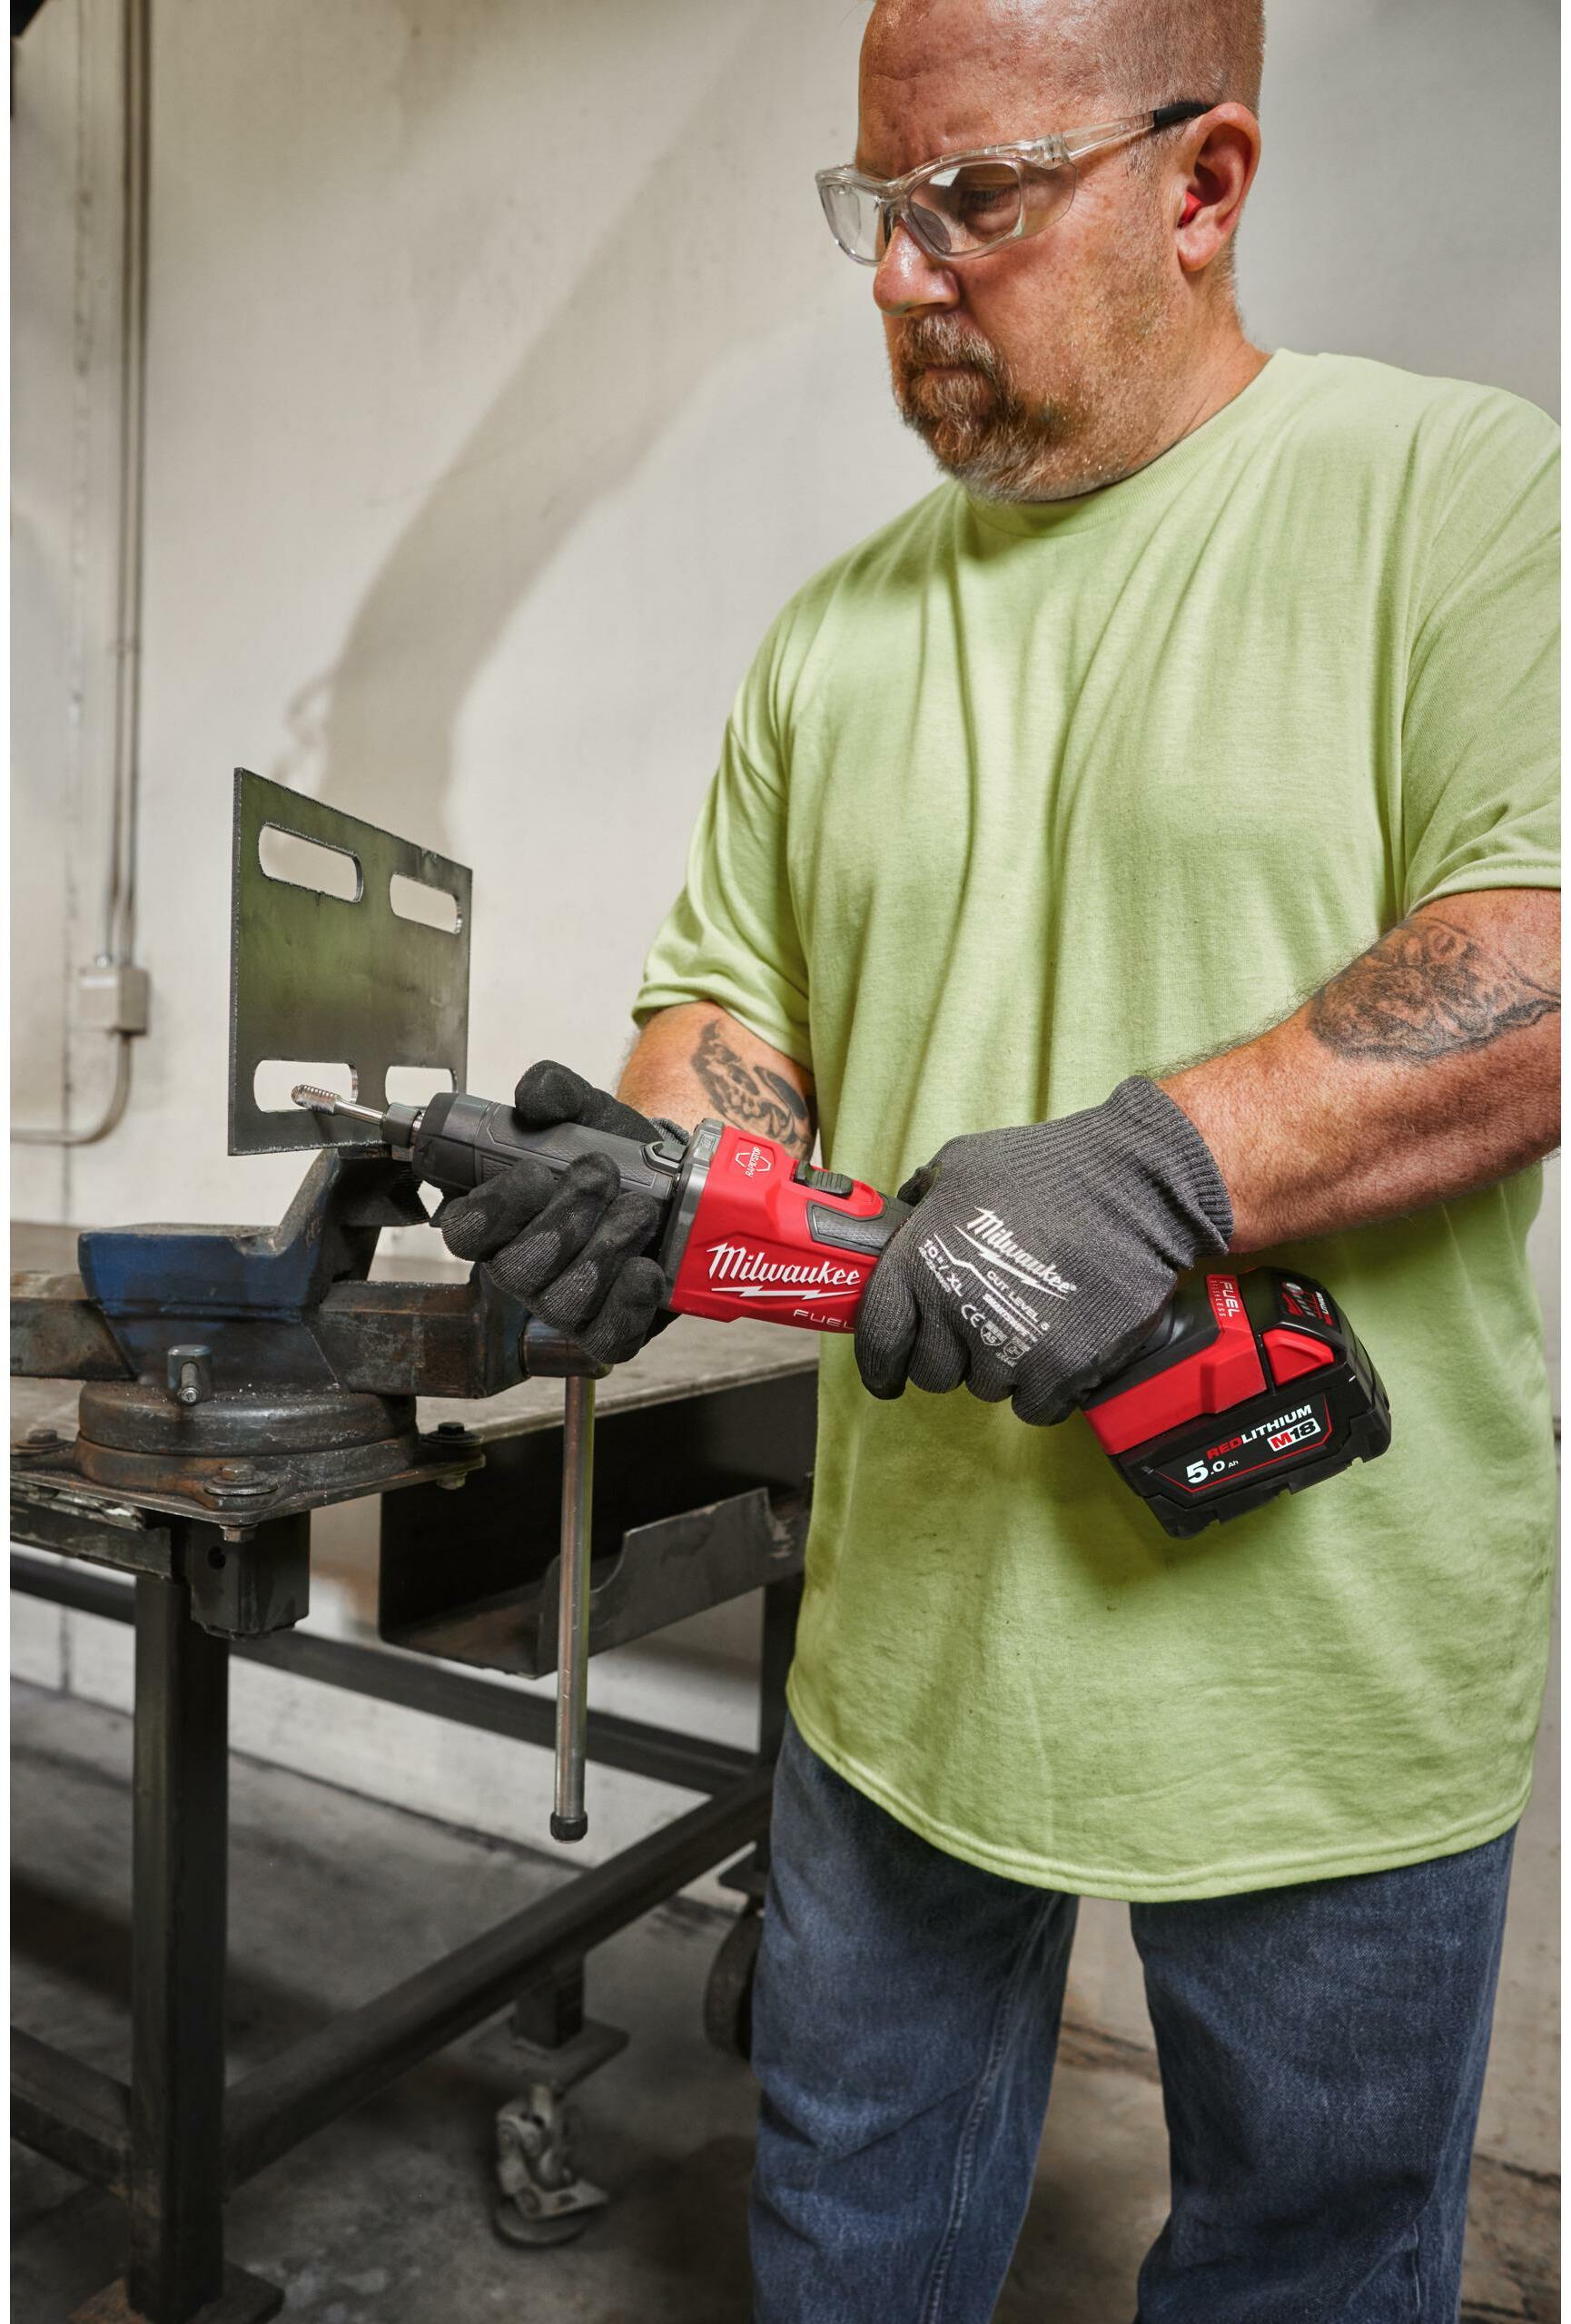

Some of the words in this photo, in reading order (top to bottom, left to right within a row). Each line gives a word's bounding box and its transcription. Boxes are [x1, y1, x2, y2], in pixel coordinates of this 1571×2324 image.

[706, 1242, 861, 1285] Milwaukee
[946, 1273, 963, 1297] XL
[987, 1270, 1010, 1291] CUT
[1008, 1291, 1039, 1323] LEVEL
[1220, 1281, 1240, 1317] FUEL
[793, 1308, 855, 1330] FUEL
[1205, 1404, 1312, 1461] REDLITHIUM
[1270, 1419, 1317, 1450] M18
[1228, 1460, 1239, 1469] Ah
